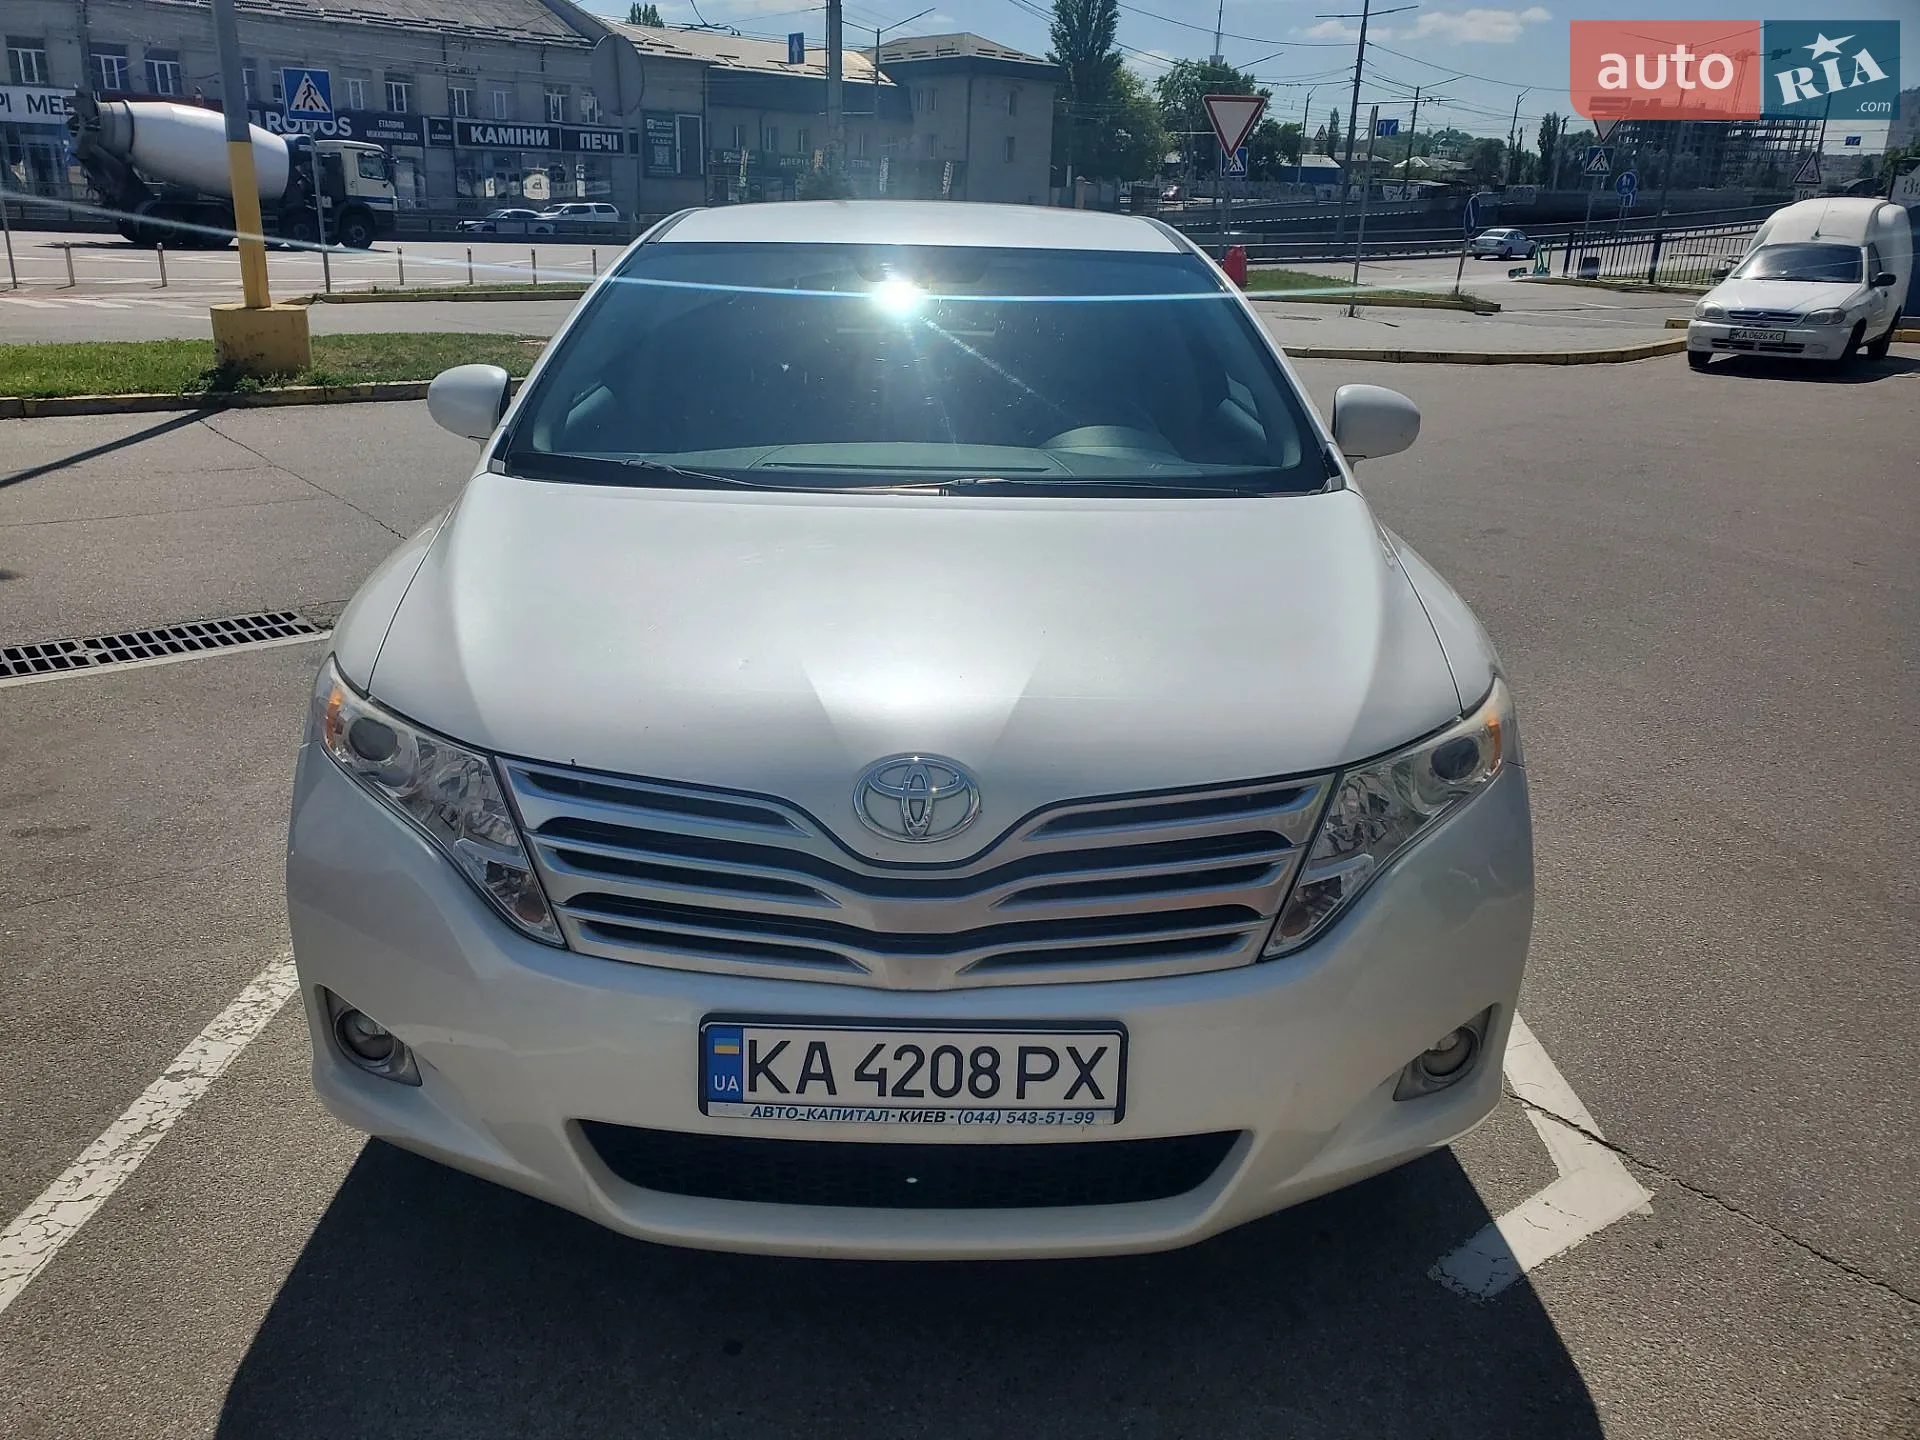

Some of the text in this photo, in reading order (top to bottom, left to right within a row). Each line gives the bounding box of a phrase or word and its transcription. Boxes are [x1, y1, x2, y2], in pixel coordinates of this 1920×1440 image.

[265, 111, 352, 137] RODOS
[470, 125, 550, 146] КАМІНИ
[579, 133, 618, 150] ПЕЧІ
[747, 1039, 1108, 1100] KA 4208 PX
[713, 1074, 740, 1092] UA
[750, 1105, 1095, 1126] АВТО-КАПИТАЛ КИЕВ (044) 543-51-99
